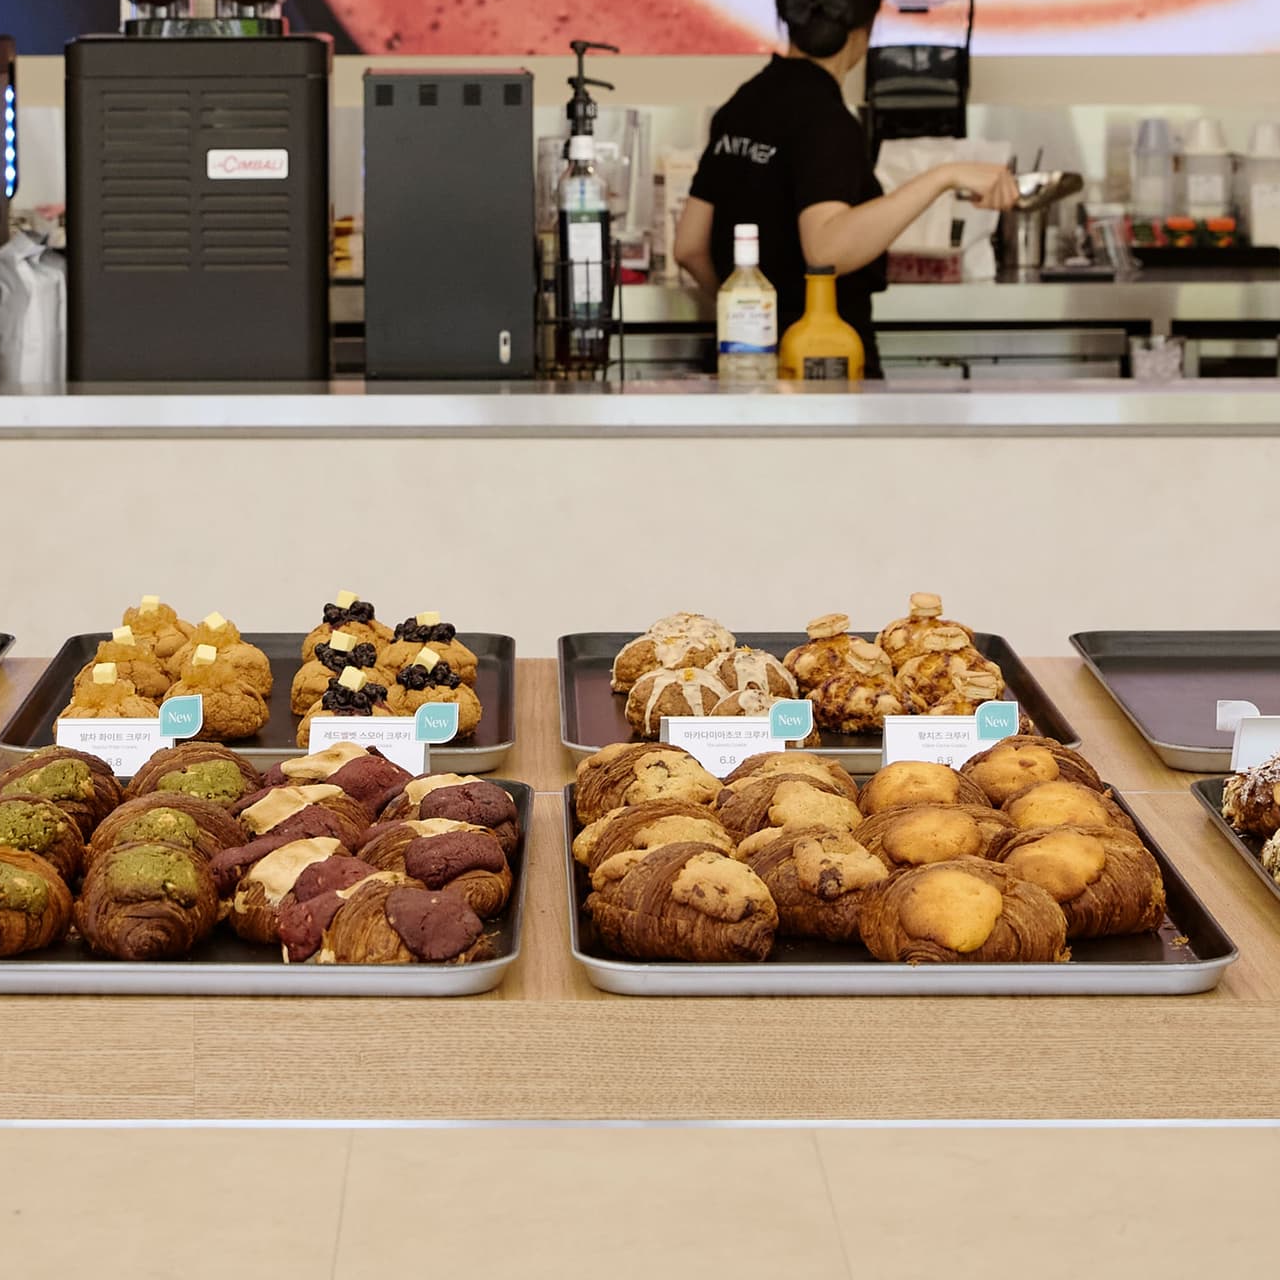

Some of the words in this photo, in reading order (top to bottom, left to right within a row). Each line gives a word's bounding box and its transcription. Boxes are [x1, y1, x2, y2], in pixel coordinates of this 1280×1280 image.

[168, 711, 193, 724] New
[423, 715, 449, 729] New
[778, 714, 802, 726] New
[984, 715, 1009, 728] New
[79, 732, 97, 742] 말차
[99, 732, 124, 742] 화이트
[125, 732, 151, 742] 크루키
[323, 730, 358, 741] 레드벨벳
[359, 730, 384, 741] 스모어
[386, 730, 411, 741] 크루키
[744, 730, 769, 740] 크루키
[945, 731, 970, 741] 크루키
[719, 755, 737, 765] 6.8
[937, 756, 954, 765] 6.8
